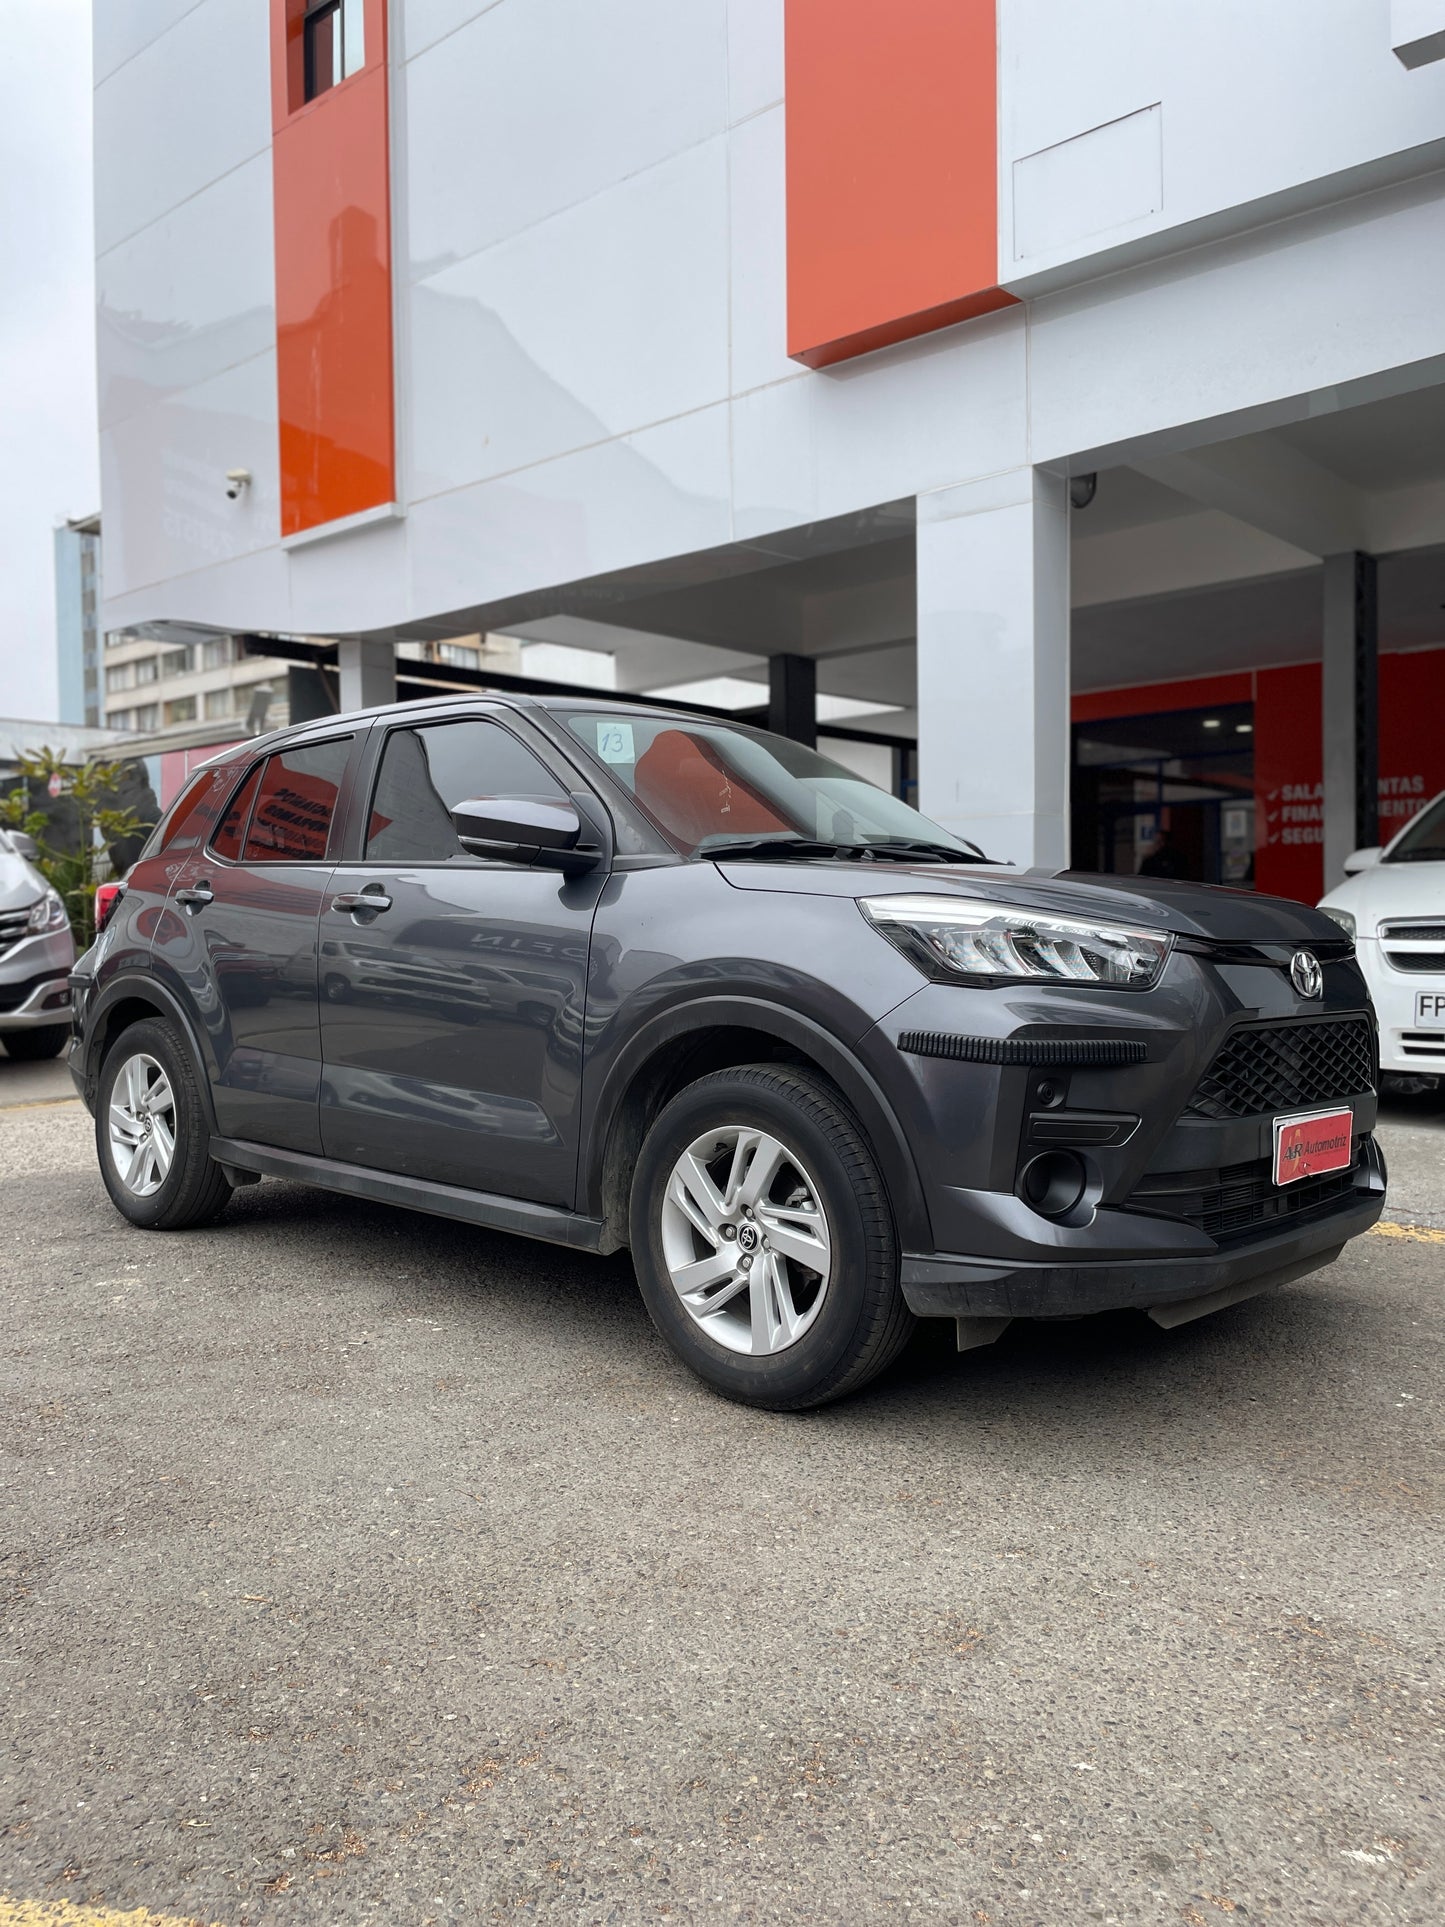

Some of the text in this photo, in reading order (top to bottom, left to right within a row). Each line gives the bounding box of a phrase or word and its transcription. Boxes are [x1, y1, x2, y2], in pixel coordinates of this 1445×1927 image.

[601, 733, 624, 753] 13
[1281, 804, 1324, 823] FINA
[1303, 1131, 1347, 1157] Automotriz
